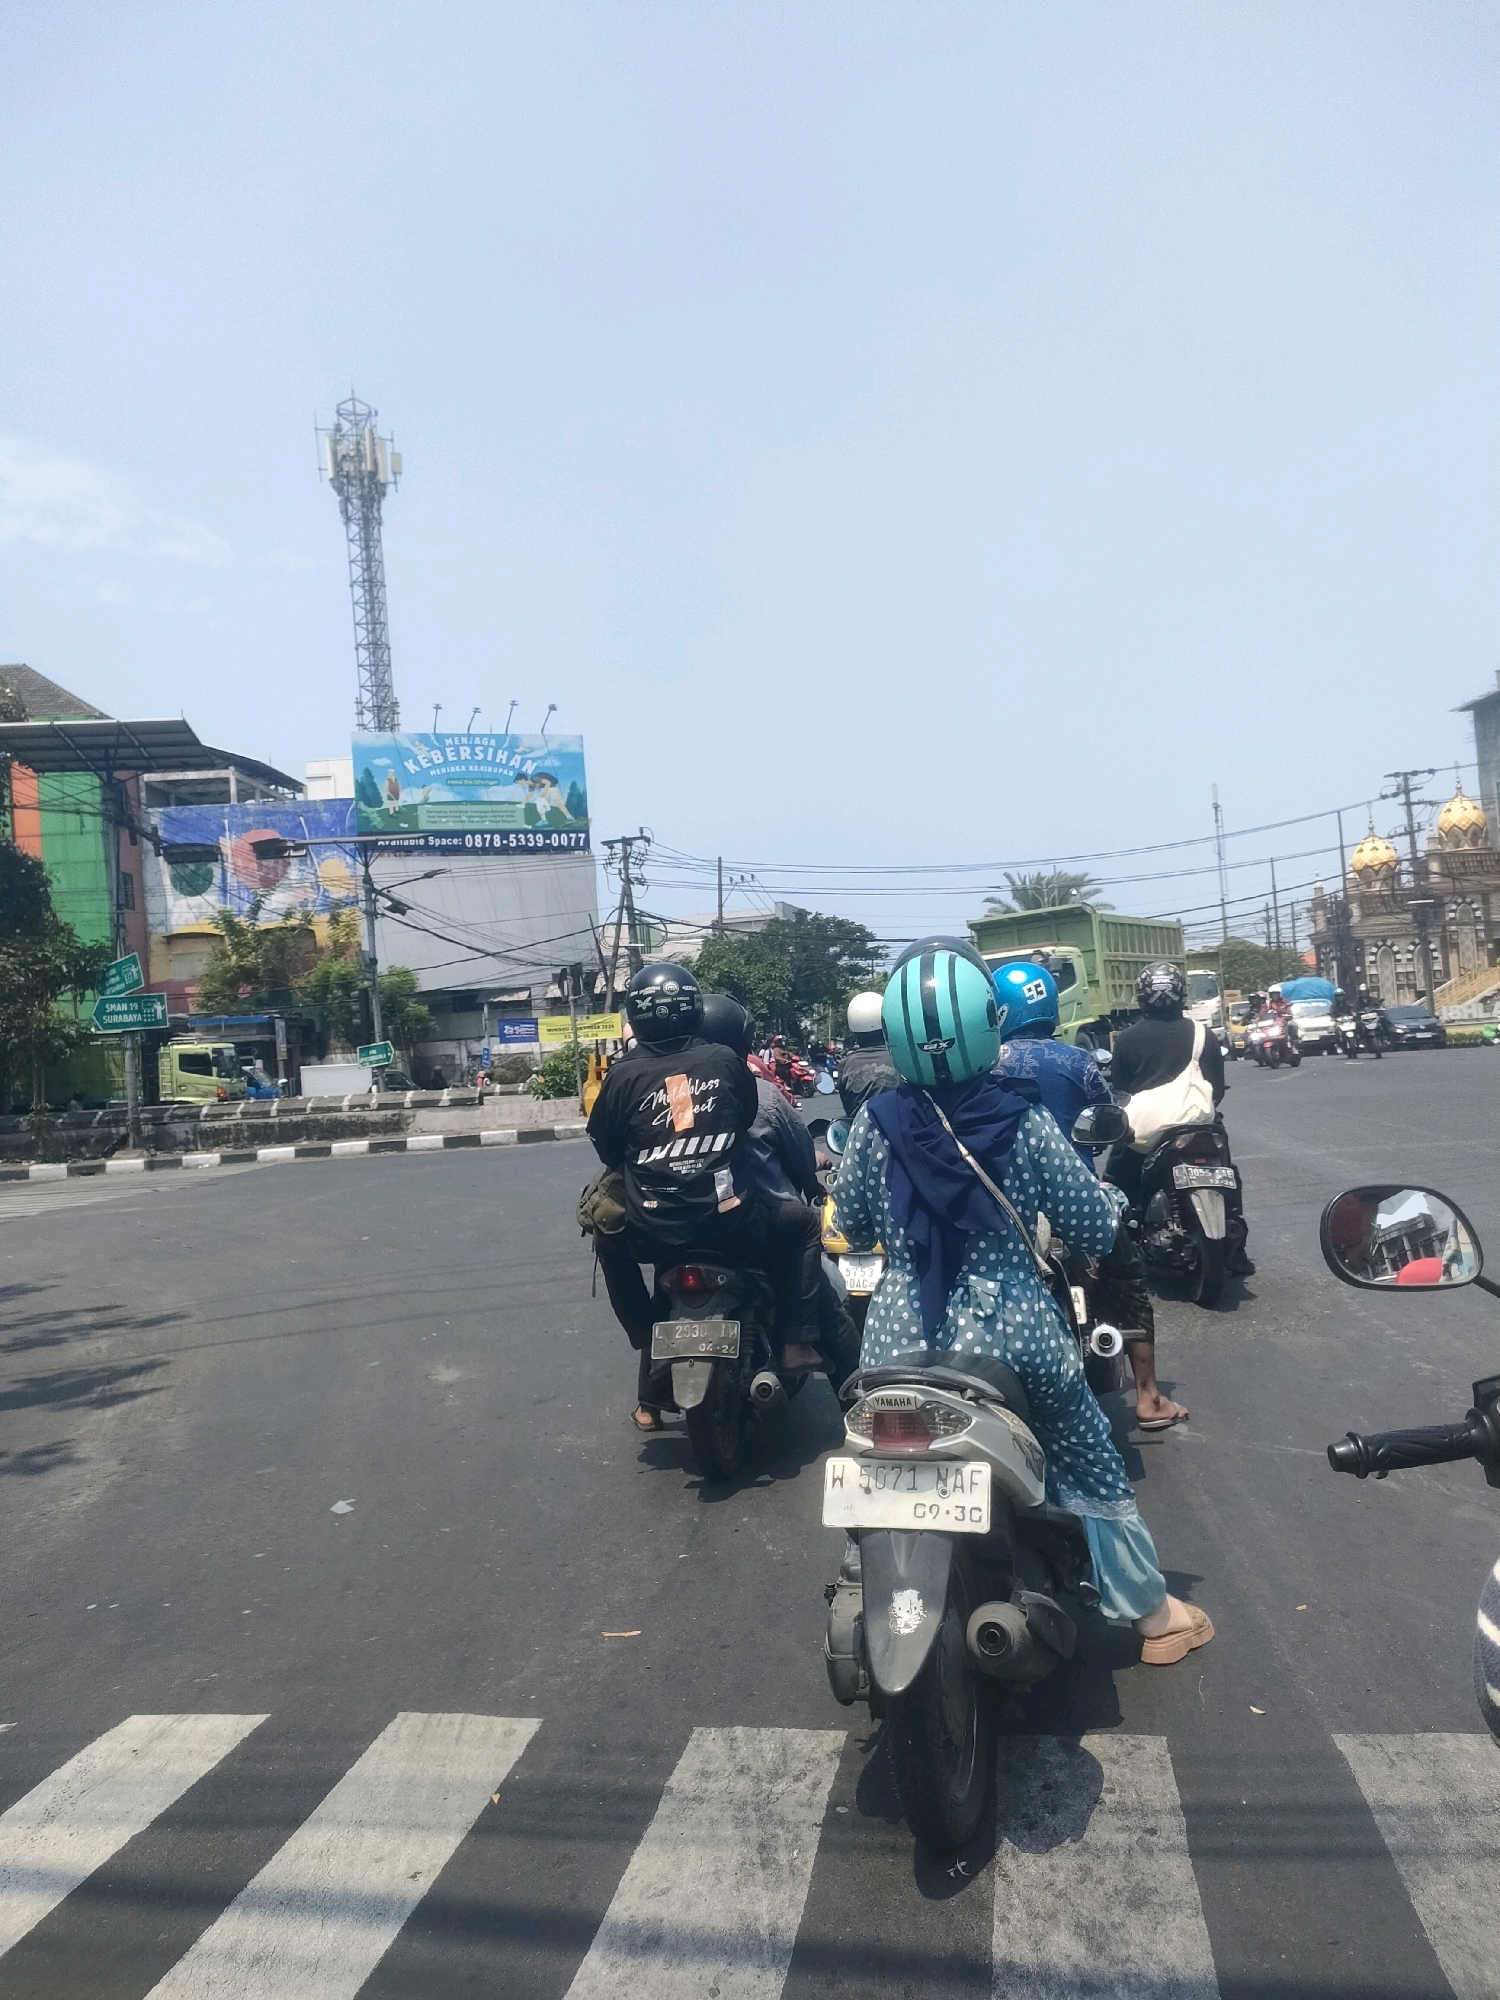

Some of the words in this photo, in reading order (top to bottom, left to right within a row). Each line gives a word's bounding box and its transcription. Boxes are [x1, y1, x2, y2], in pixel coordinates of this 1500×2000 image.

[444, 737, 496, 747] MENJAGA
[403, 746, 538, 775] KEBERSIHAN
[429, 765, 466, 776] MENJAGA
[468, 765, 514, 777] KEHIDUPAN
[428, 837, 463, 848] Space:
[465, 833, 586, 848] 0878-5339-0077
[106, 1003, 128, 1013] SMAN
[130, 1002, 139, 1011] 19
[103, 1013, 142, 1024] SURABAYA
[845, 1267, 874, 1278] 5753
[655, 1325, 663, 1340] L
[874, 1397, 912, 1407] YAMAHA
[831, 1464, 844, 1489] W
[858, 1464, 918, 1491] 5071
[935, 1467, 983, 1494] NAF
